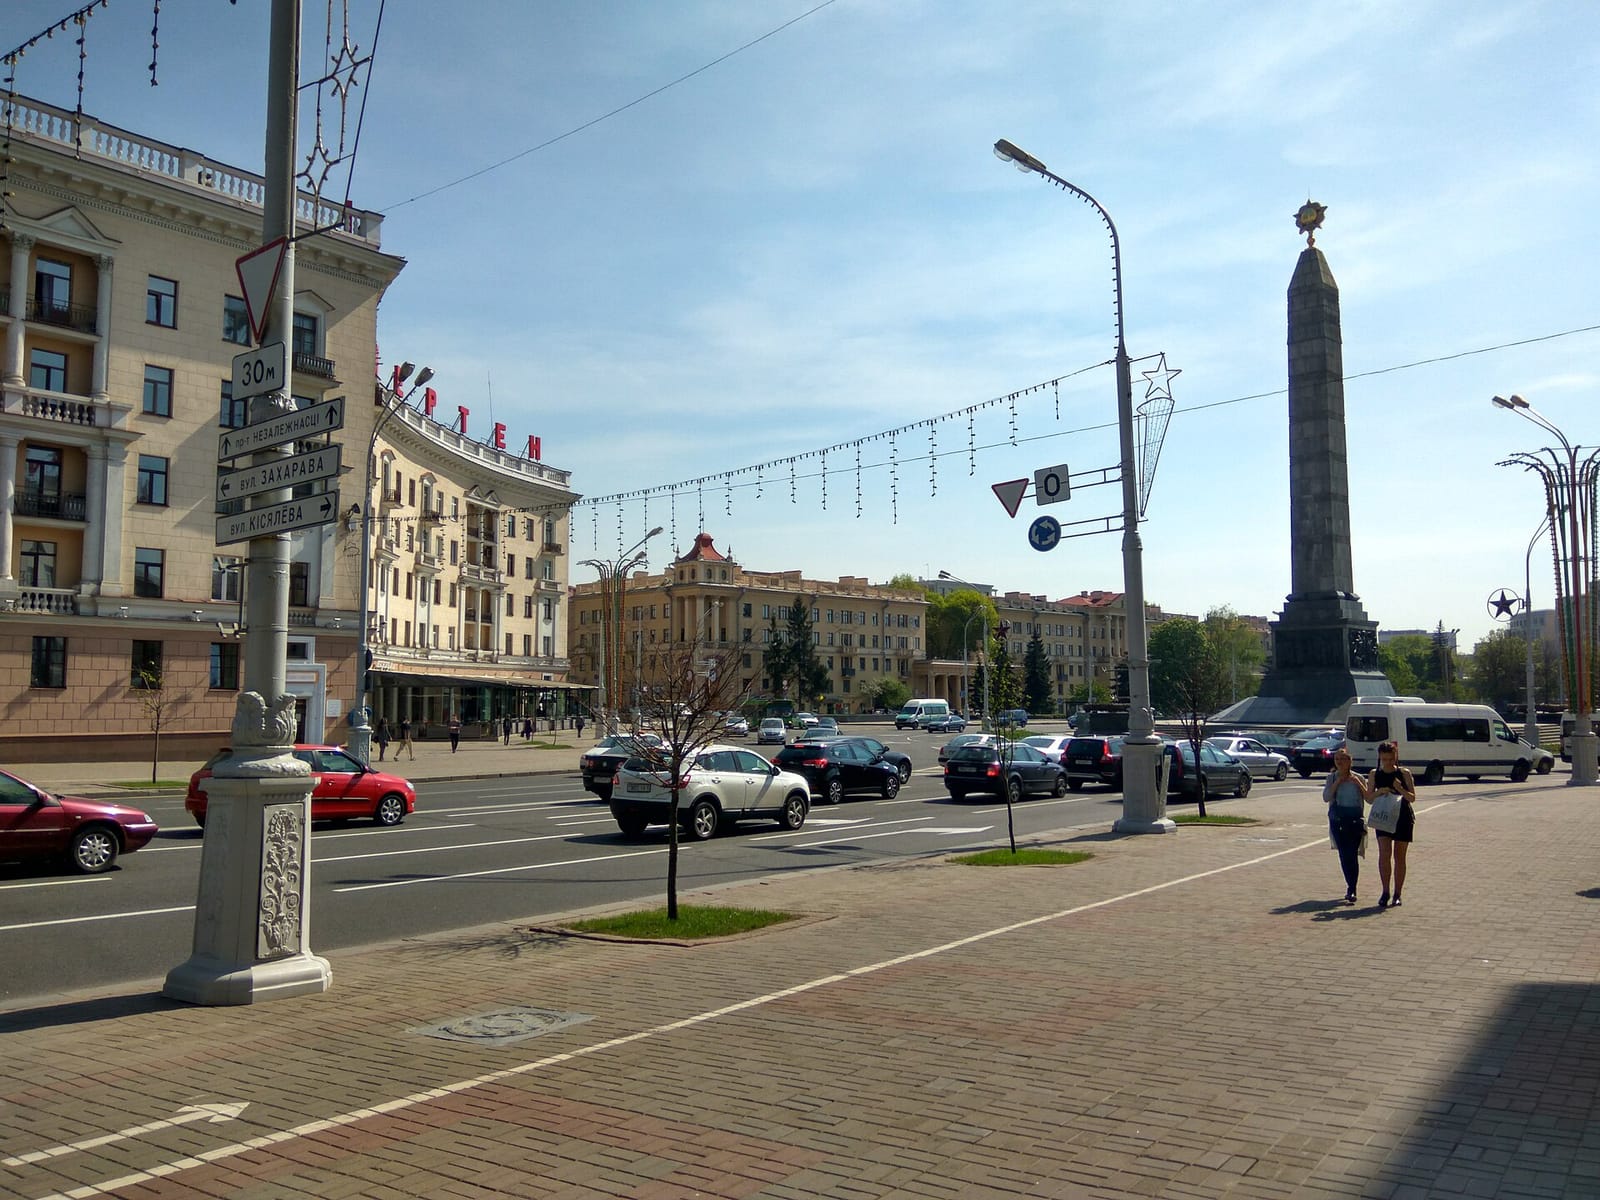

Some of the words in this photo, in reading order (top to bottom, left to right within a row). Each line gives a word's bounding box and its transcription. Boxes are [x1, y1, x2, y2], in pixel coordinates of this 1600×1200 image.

[375, 343, 541, 461] ЕРТЕН
[253, 413, 320, 443] НЕЗАЛЕЖНАСЦІ
[261, 456, 324, 485] ЗАХАРАВА
[249, 505, 303, 531] КІСЯЛЁВА
